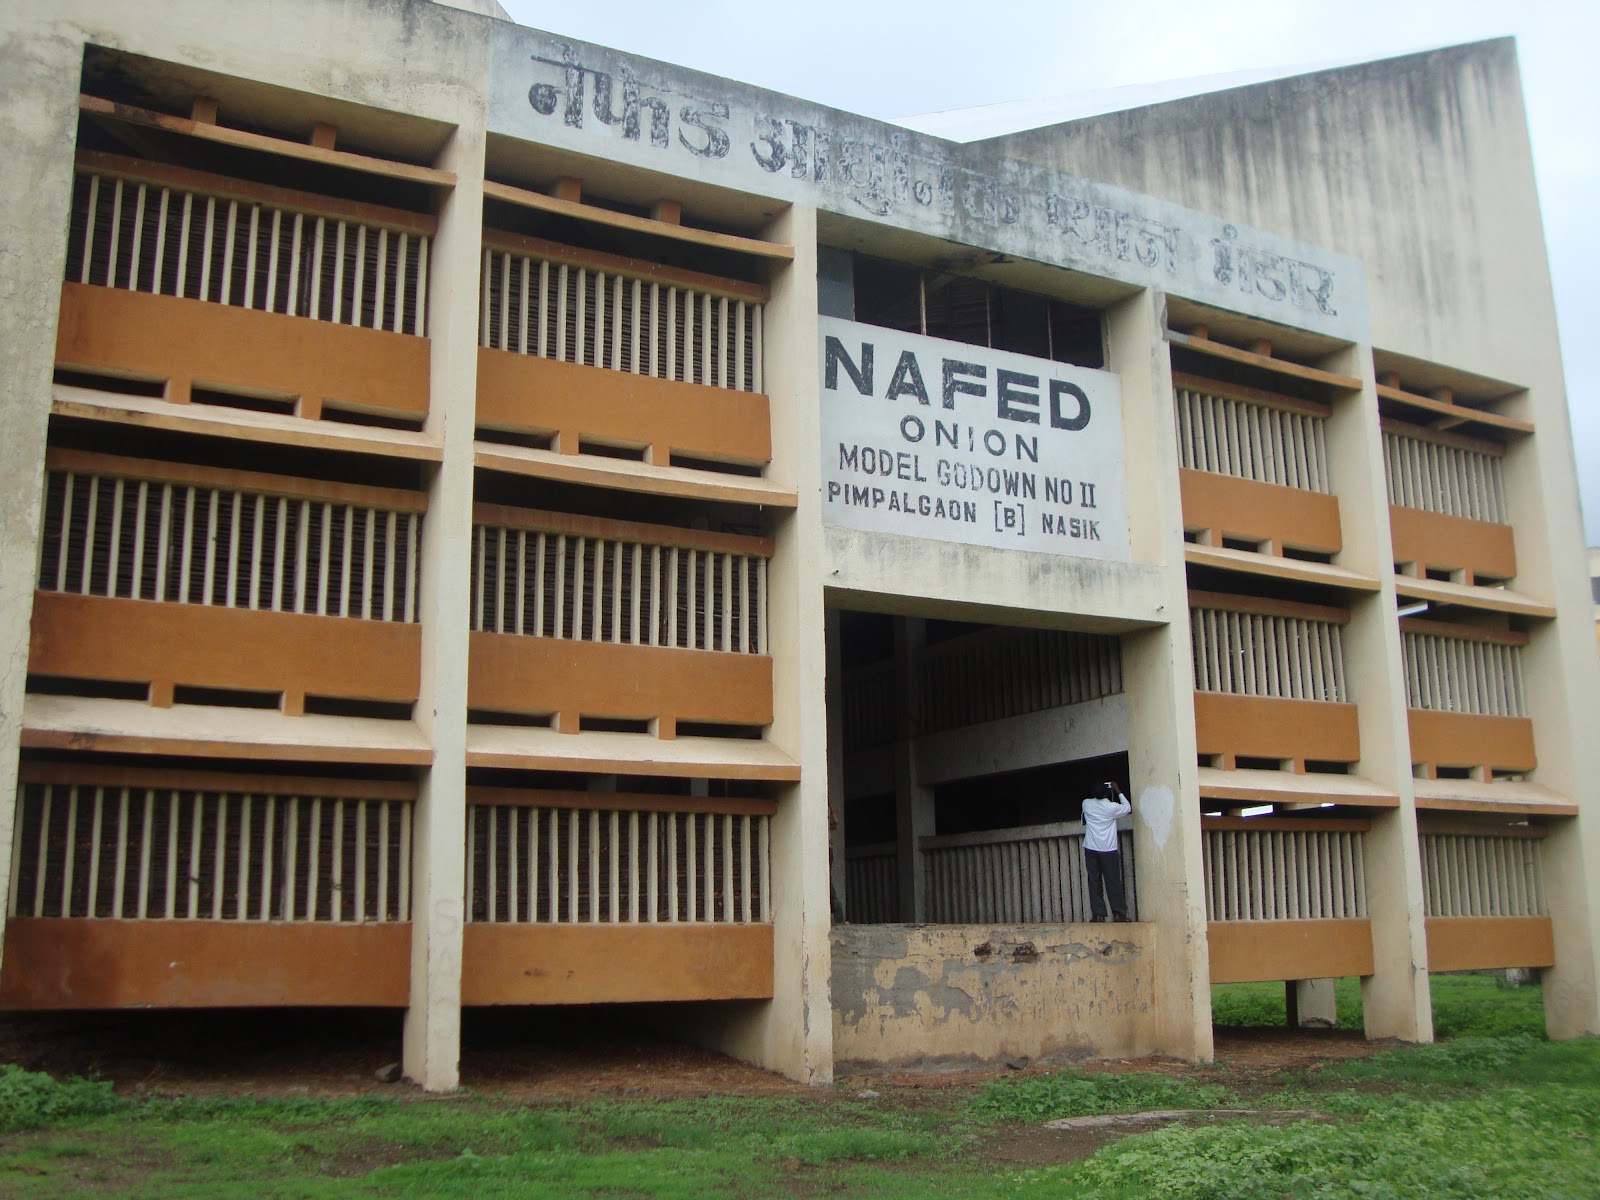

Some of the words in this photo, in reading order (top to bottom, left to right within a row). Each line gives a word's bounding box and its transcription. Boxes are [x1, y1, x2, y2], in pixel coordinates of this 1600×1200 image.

[1209, 223, 1338, 317] भंडार
[824, 335, 1092, 432] NAFED
[899, 414, 1039, 463] ONION
[839, 442, 927, 483] MODEL
[936, 458, 1036, 500] GODOWN
[1044, 475, 1073, 508] NO
[1079, 481, 1097, 509] II
[827, 481, 977, 523] PIMPALGAON
[994, 500, 1026, 537] [B]
[1041, 512, 1101, 541] NASIK
